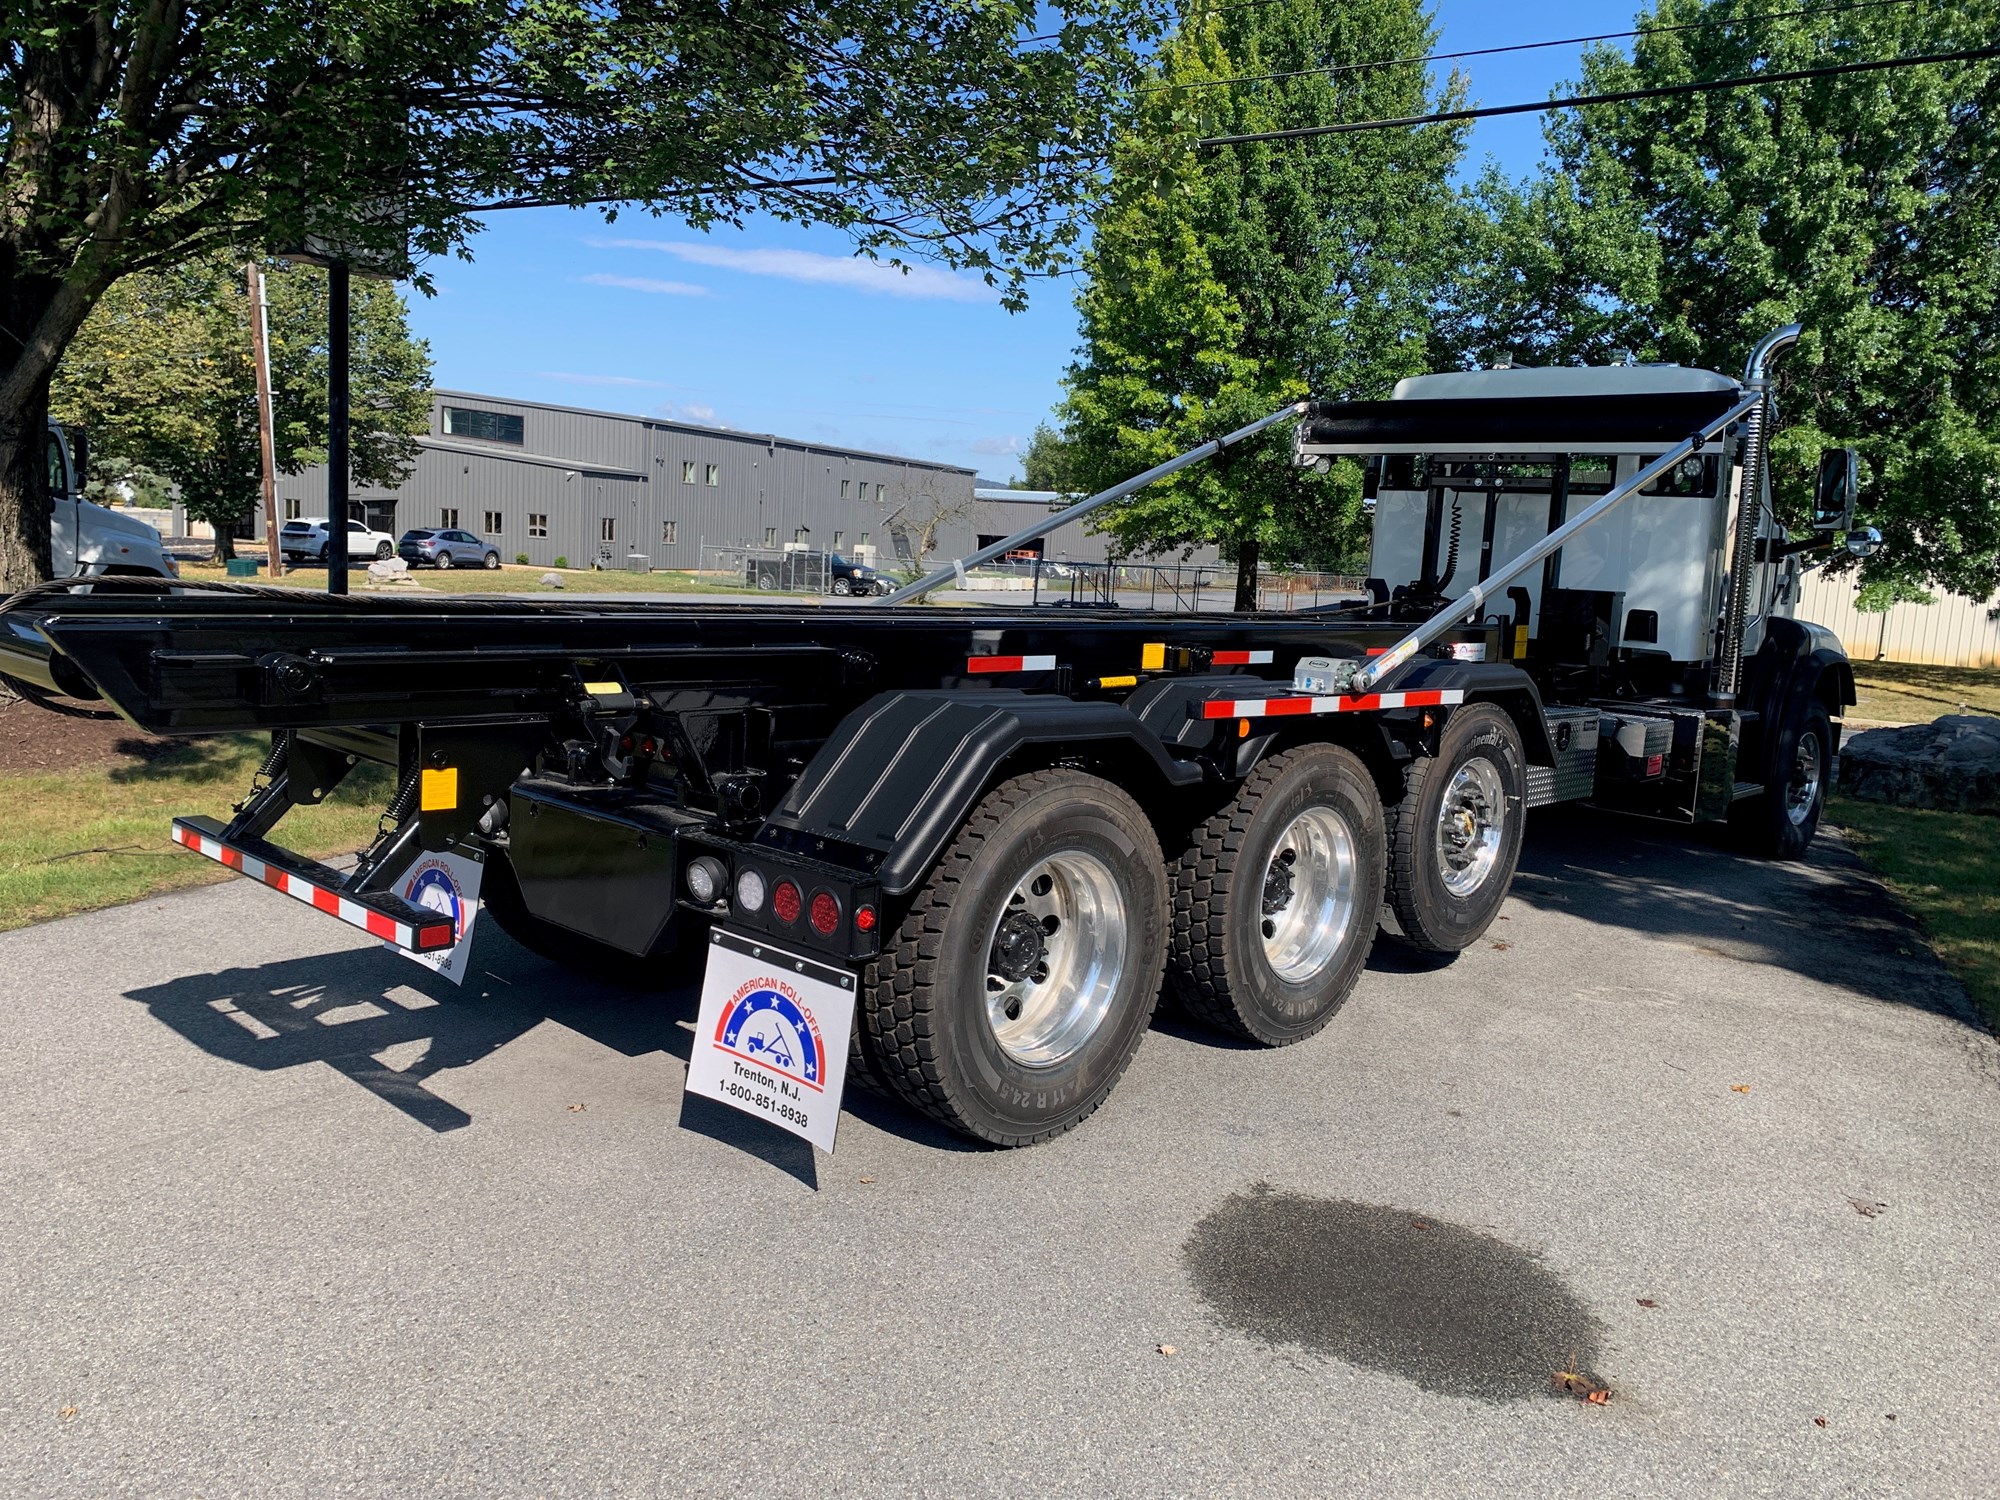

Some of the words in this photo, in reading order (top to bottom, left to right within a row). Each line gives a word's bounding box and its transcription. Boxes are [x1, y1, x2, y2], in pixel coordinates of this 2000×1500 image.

[412, 859, 440, 883] AMERICAN
[732, 976, 778, 1005] AMERICAN
[733, 1061, 777, 1092] Trenton,
[781, 1080, 801, 1102] N.J.
[719, 1079, 808, 1129] 1-800-851-8938
[998, 1082, 1030, 1109] 24.5
[1037, 1092, 1047, 1109] R
[1053, 1087, 1066, 1106] 11
